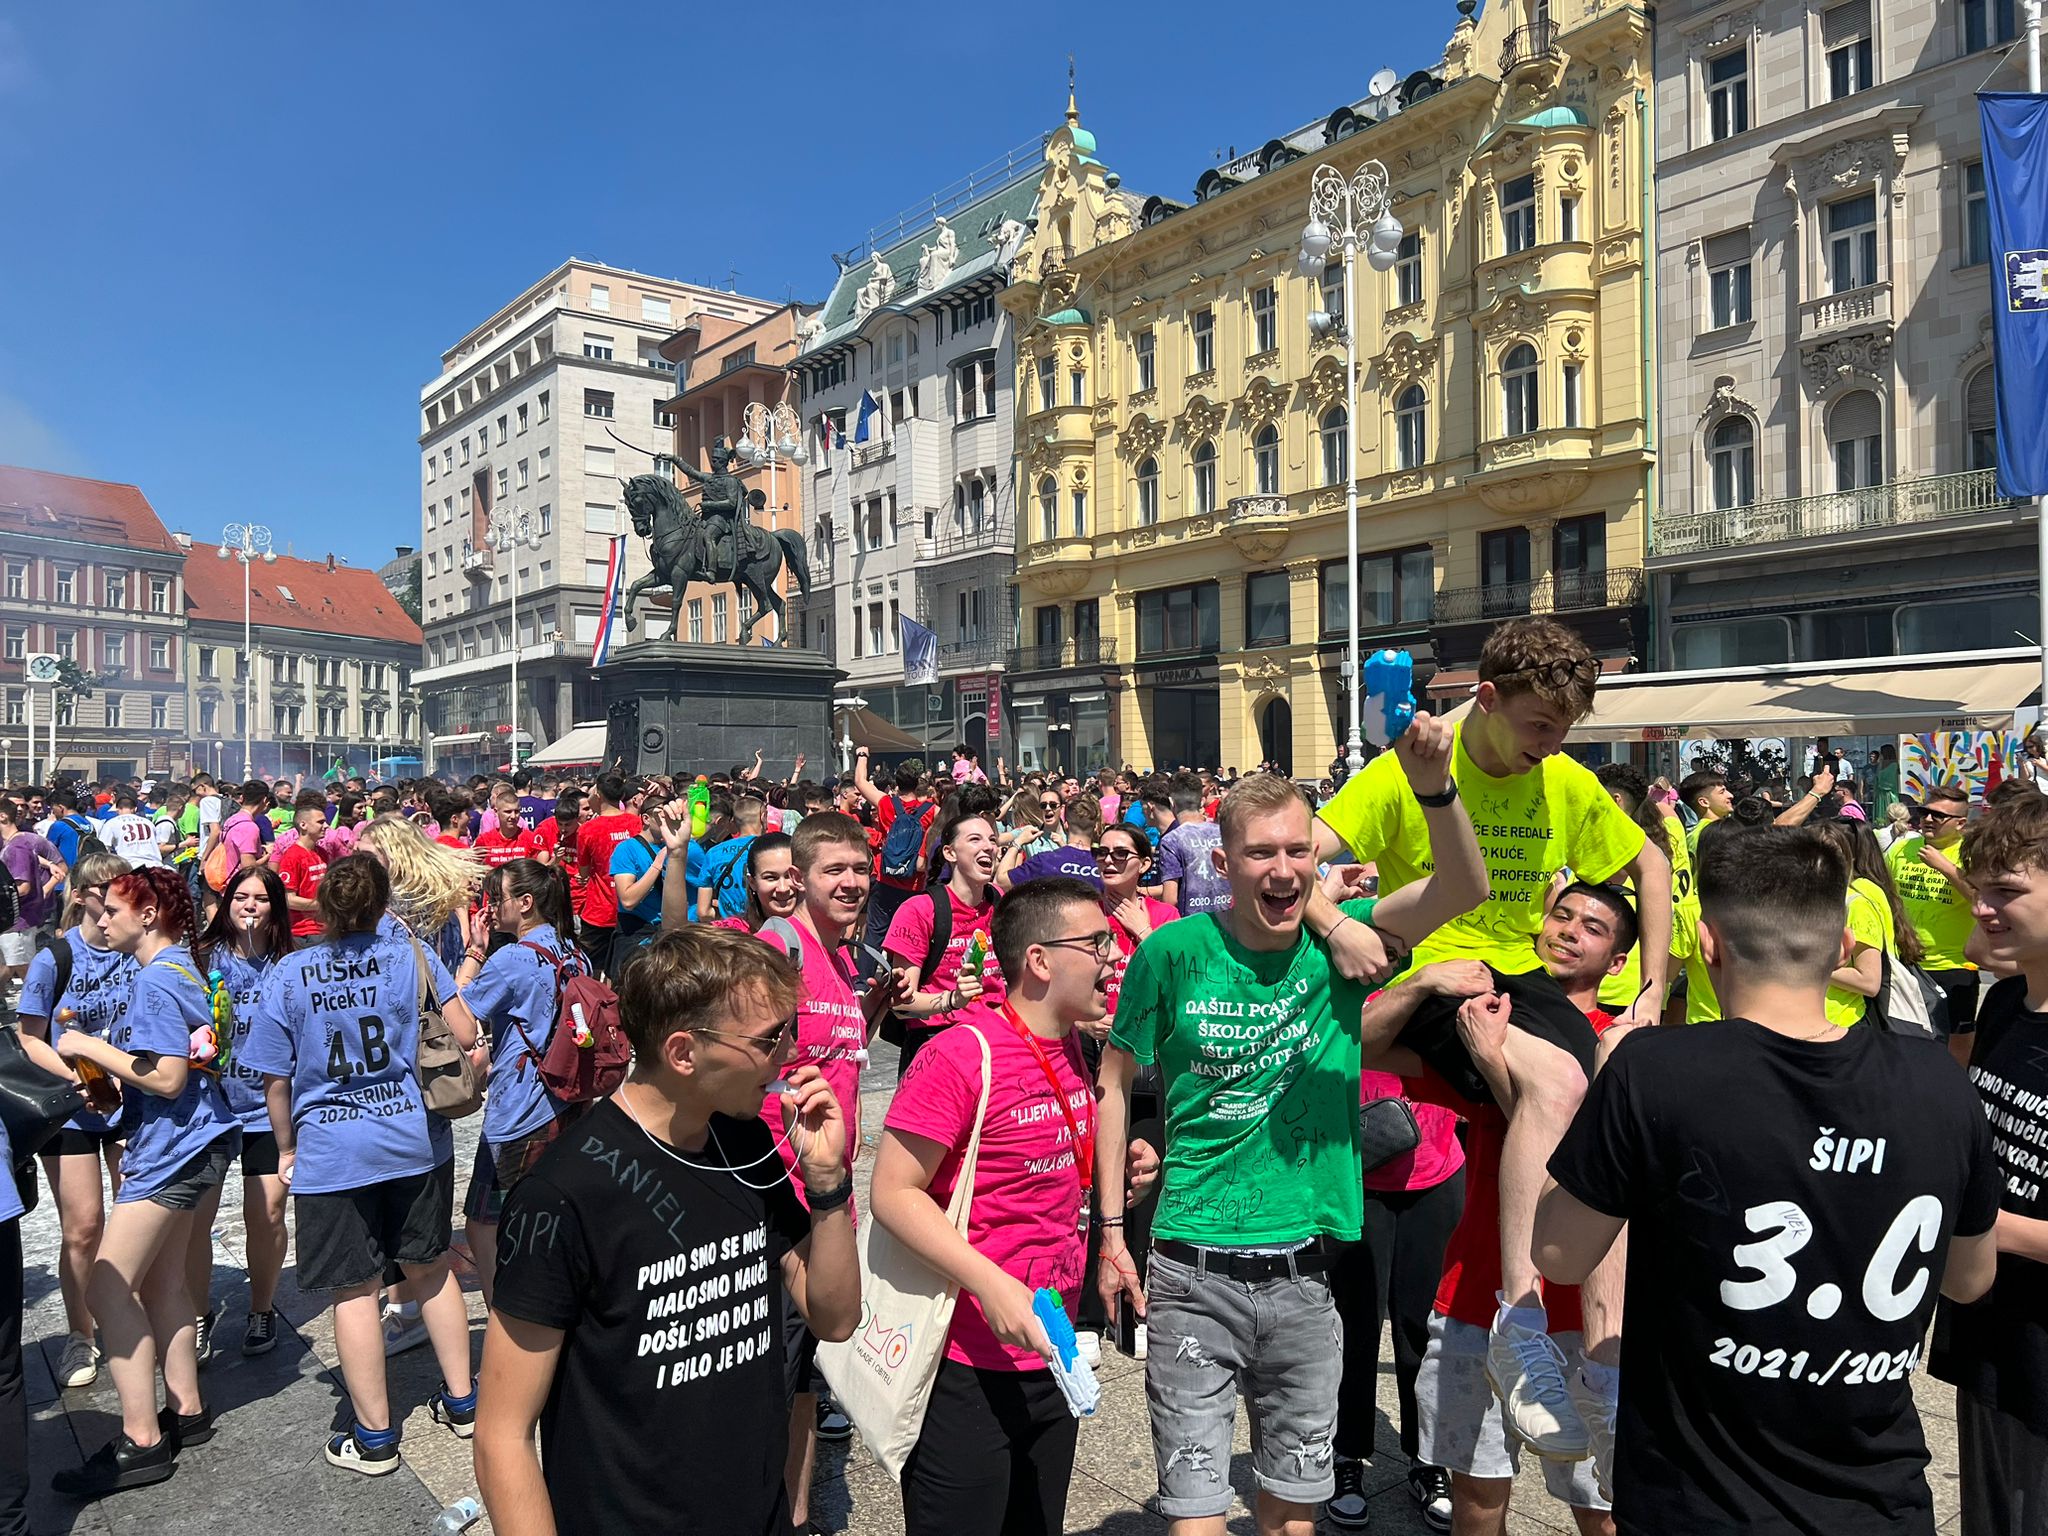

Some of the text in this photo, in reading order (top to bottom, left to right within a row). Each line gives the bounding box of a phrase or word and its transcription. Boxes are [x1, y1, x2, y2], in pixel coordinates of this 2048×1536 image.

[1155, 667, 1201, 683] HARMICA
[72, 745, 129, 754] HOLDING
[122, 823, 152, 842] 3D
[1492, 826, 1507, 838] SE
[1510, 827, 1554, 840] REDALE
[1490, 844, 1528, 862] KUĆE,
[1500, 887, 1532, 902] MUČE
[311, 987, 358, 1014] Picek
[360, 985, 378, 1008] 17
[326, 1014, 391, 1086] 4.B
[1200, 1041, 1235, 1059] IŠLI
[1190, 1060, 1257, 1081] MANJEG
[1978, 1070, 2003, 1095] SMO
[1809, 1126, 1887, 1175] ŠIPI
[580, 1135, 687, 1249] DANIEL
[499, 1206, 561, 1266] ŠIPI
[637, 1252, 687, 1291] PUNO
[690, 1240, 717, 1271] SMO
[720, 1236, 740, 1261] SE
[637, 1319, 694, 1357] DOŠLI
[694, 1312, 728, 1342] SMO
[732, 1302, 751, 1330] DO
[656, 1365, 667, 1389] I
[671, 1356, 711, 1387] BILO
[716, 1345, 734, 1373] JE
[736, 1337, 755, 1365] DO
[856, 1346, 874, 1367] MLADE
